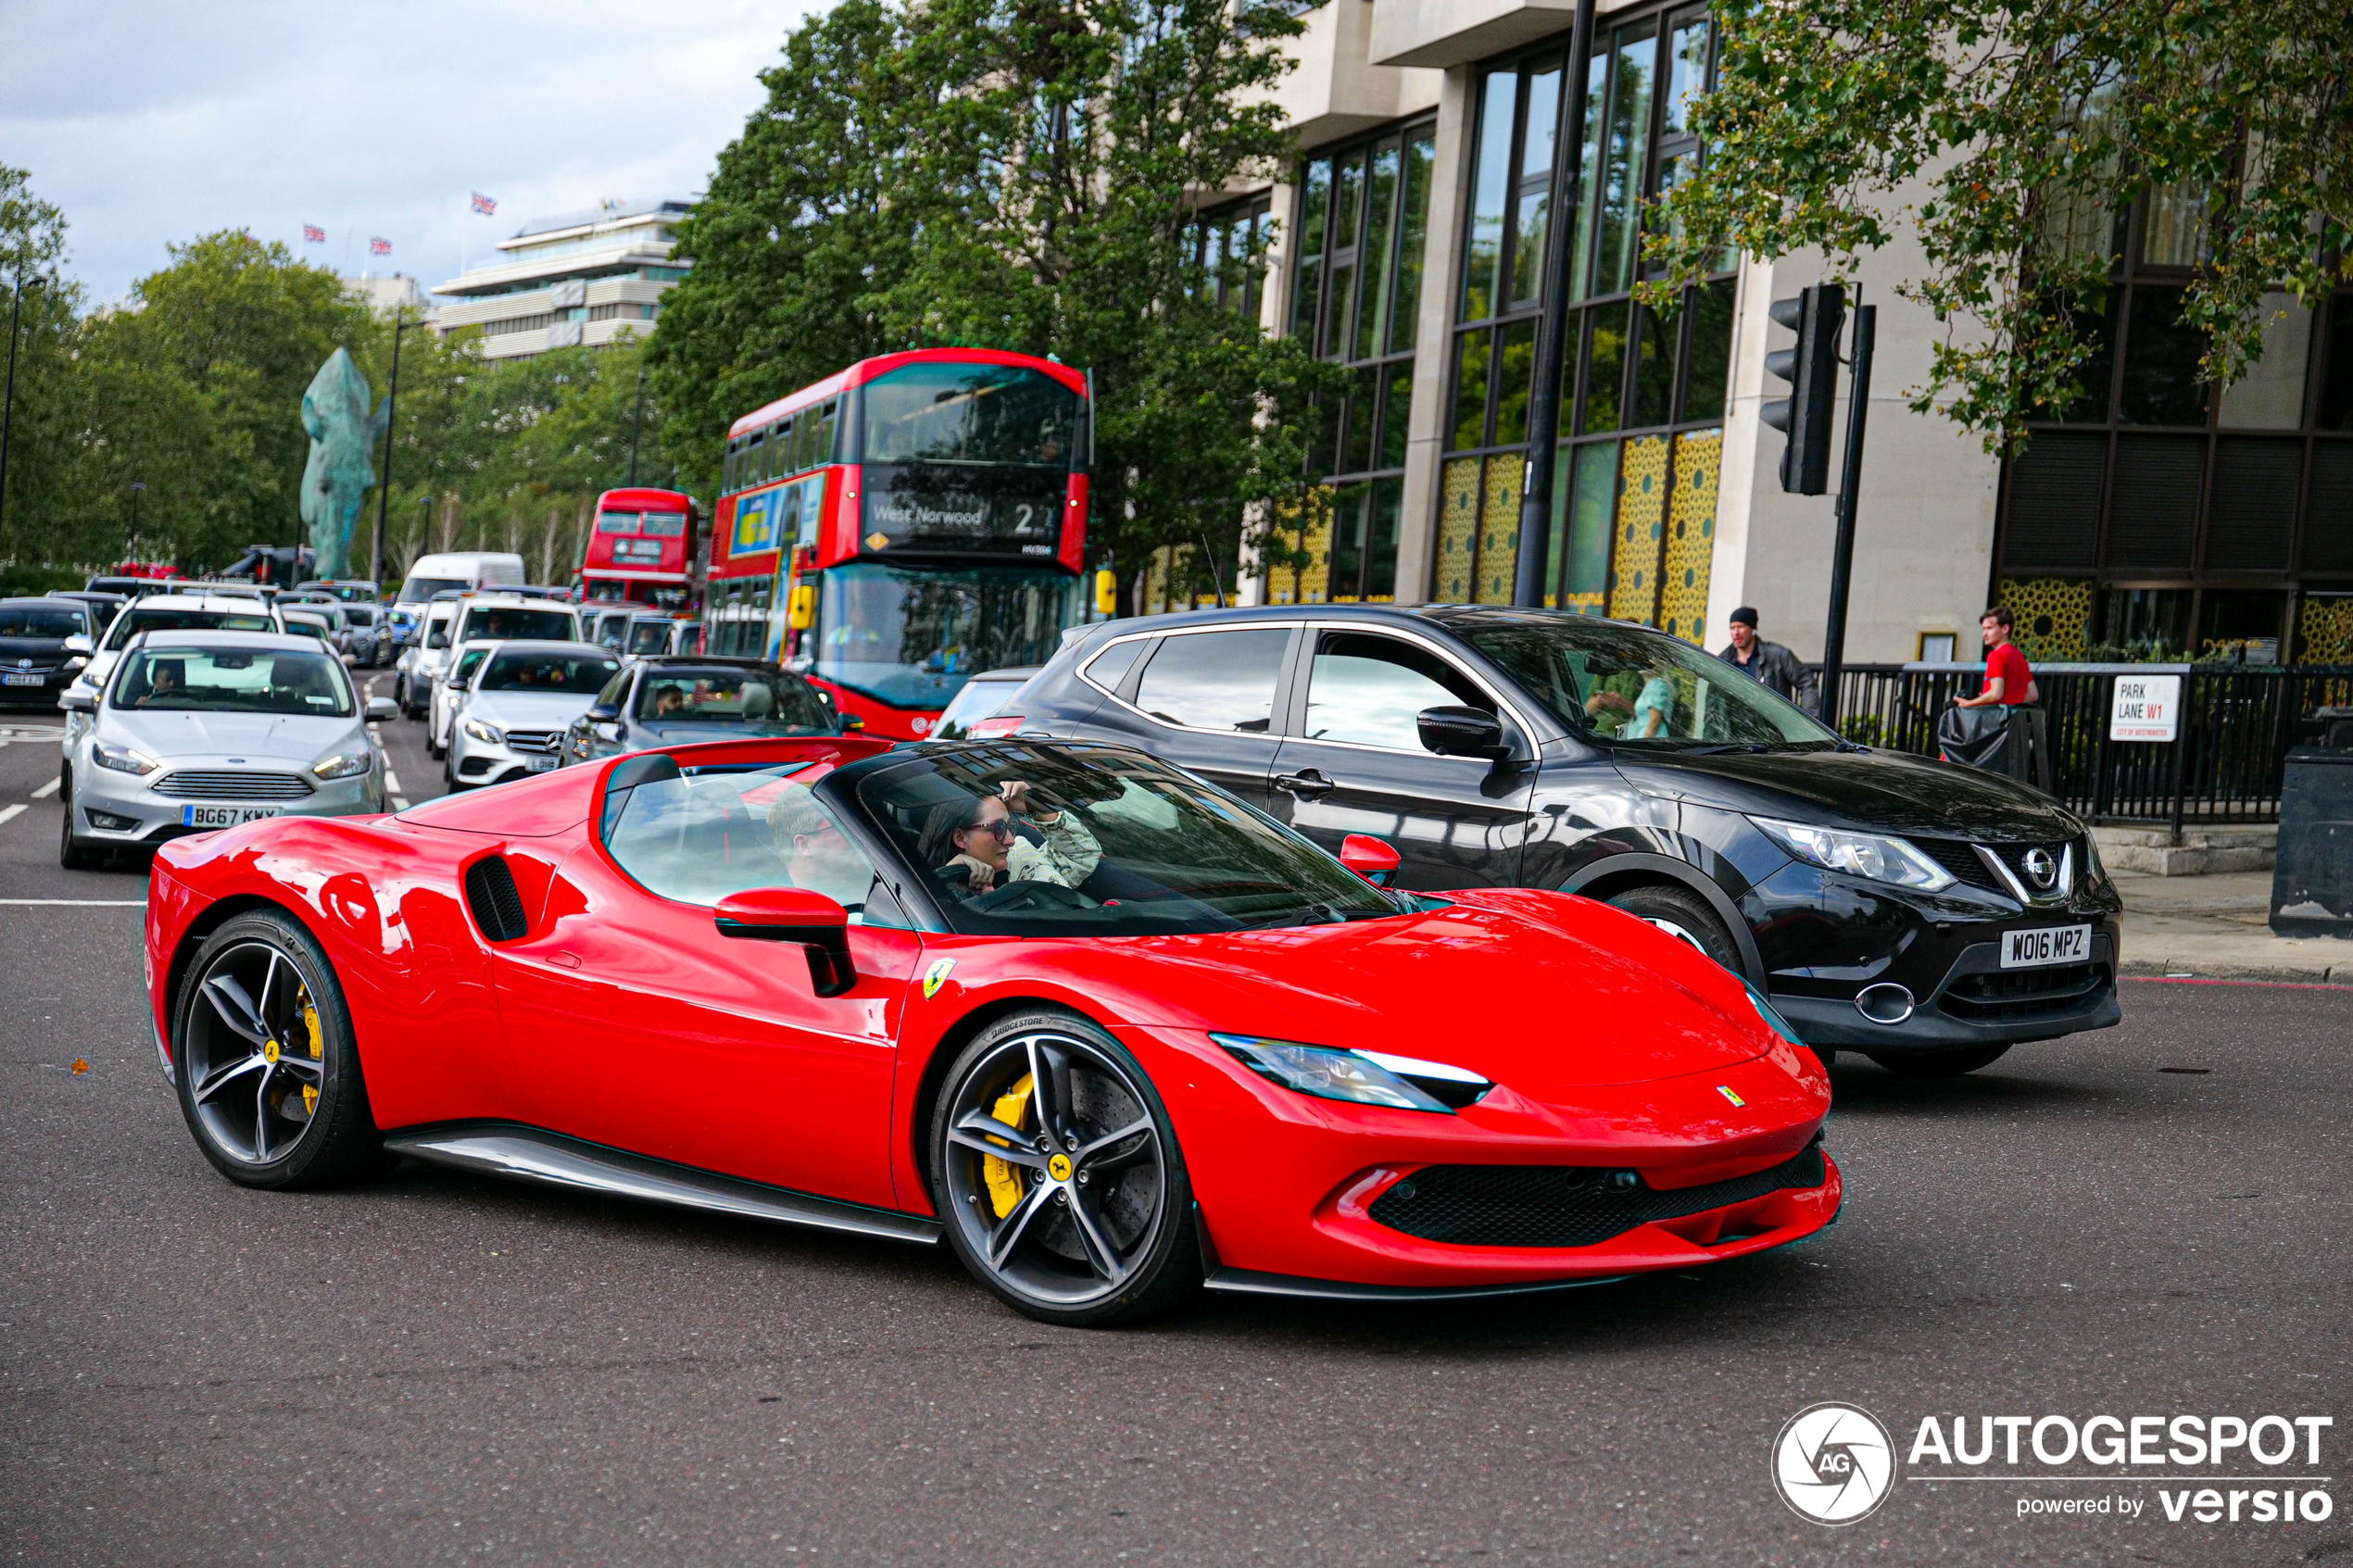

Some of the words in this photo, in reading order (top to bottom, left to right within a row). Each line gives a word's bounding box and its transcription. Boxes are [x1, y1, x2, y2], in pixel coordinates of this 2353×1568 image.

[874, 506, 912, 523] West
[916, 508, 983, 526] Norwood
[1014, 503, 1033, 534] 2
[2120, 684, 2146, 698] PARK
[2119, 704, 2144, 719] LANE
[2147, 704, 2163, 719] W1
[2117, 728, 2127, 736] CITY
[2128, 728, 2133, 736] OF
[195, 808, 239, 825] BG67
[2053, 929, 2082, 958] MPZ
[991, 1017, 1044, 1039] BRIDGESTONE
